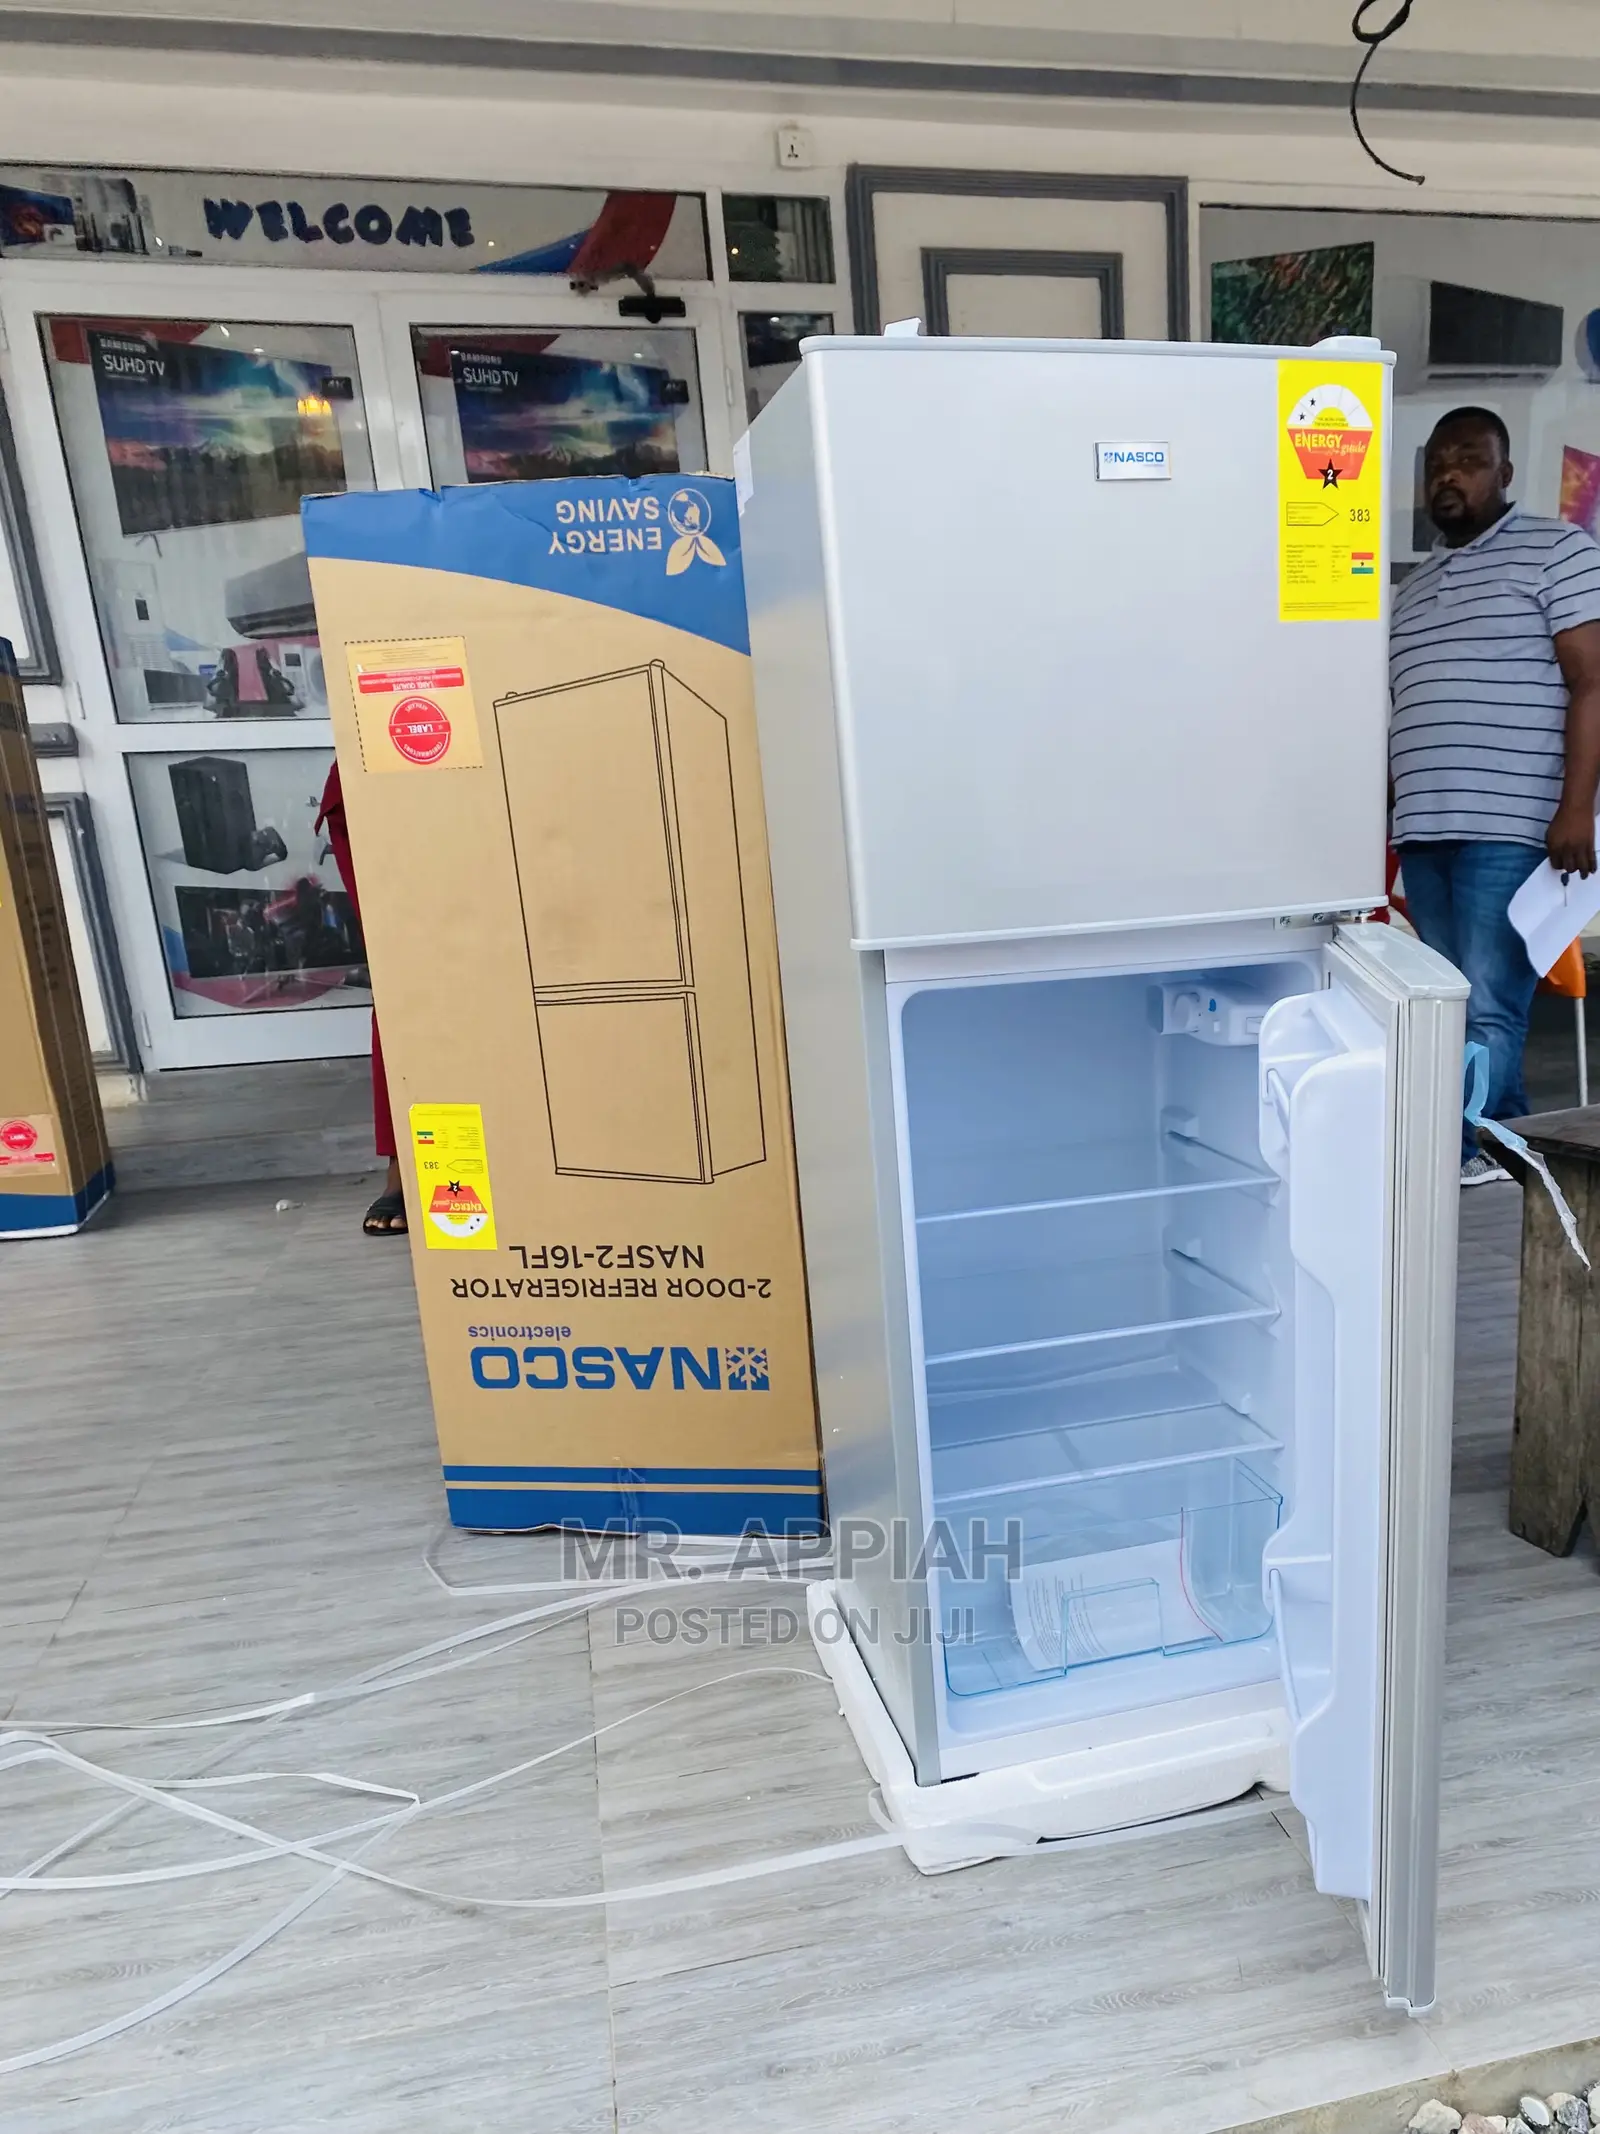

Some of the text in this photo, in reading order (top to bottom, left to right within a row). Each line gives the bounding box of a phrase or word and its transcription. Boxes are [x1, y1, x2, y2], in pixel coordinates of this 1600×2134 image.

[203, 199, 475, 247] WELCOME
[1295, 429, 1343, 452] ENERGY
[1114, 452, 1164, 462] NASCO
[1327, 469, 1334, 480] 2
[556, 496, 660, 523] SAVING
[1349, 508, 1370, 522] 383
[548, 527, 662, 554] ENERGY
[407, 723, 433, 733] LABEL
[423, 1161, 440, 1170] 383
[449, 1201, 482, 1212] ENERGY
[509, 1245, 704, 1269] NASF2-16FL
[450, 1278, 772, 1298] 2-DOOR REFRIGERATOR
[468, 1325, 571, 1341] electronics
[470, 1346, 721, 1390] NASCO
